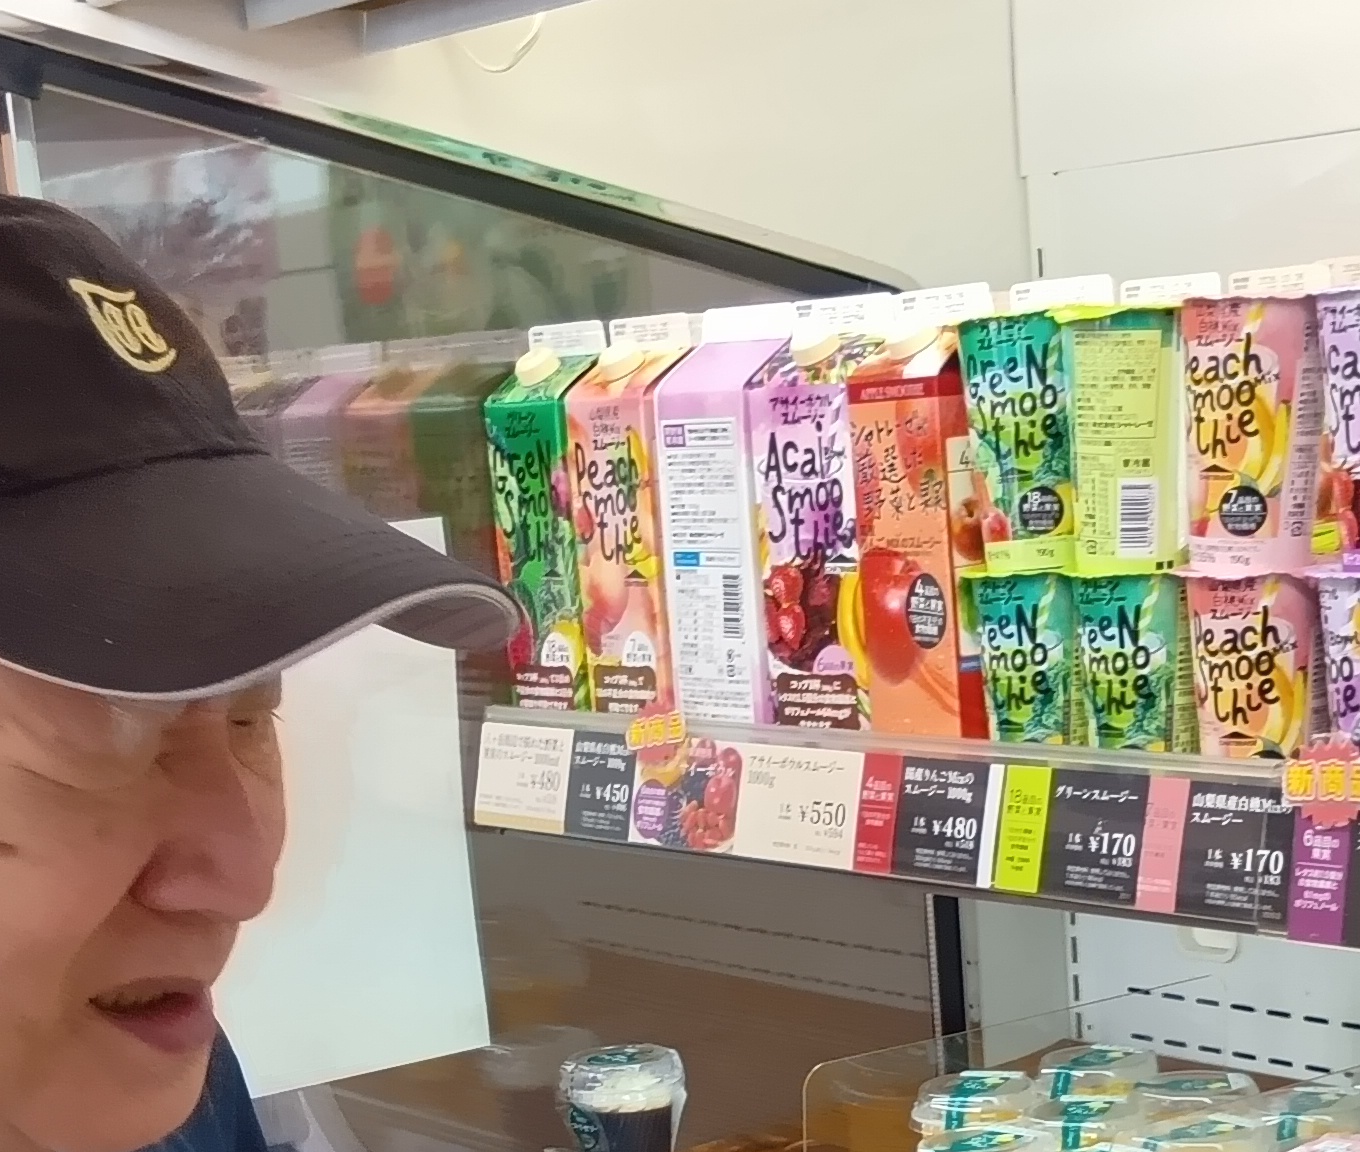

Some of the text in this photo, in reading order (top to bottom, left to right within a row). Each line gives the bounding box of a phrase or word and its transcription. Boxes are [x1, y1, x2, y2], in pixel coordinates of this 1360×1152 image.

[1194, 407, 1260, 459] thie
[575, 434, 639, 491] Peach
[764, 420, 828, 485] Acai
[1210, 677, 1281, 726] thie
[595, 783, 630, 803] ¥450
[1055, 785, 1139, 803] グリーンスムージー
[800, 800, 847, 829] ¥550
[1190, 812, 1244, 826] スムージー
[932, 816, 978, 841] ¥480
[1088, 831, 1137, 857] ¥170
[1229, 849, 1284, 875] ¥170
